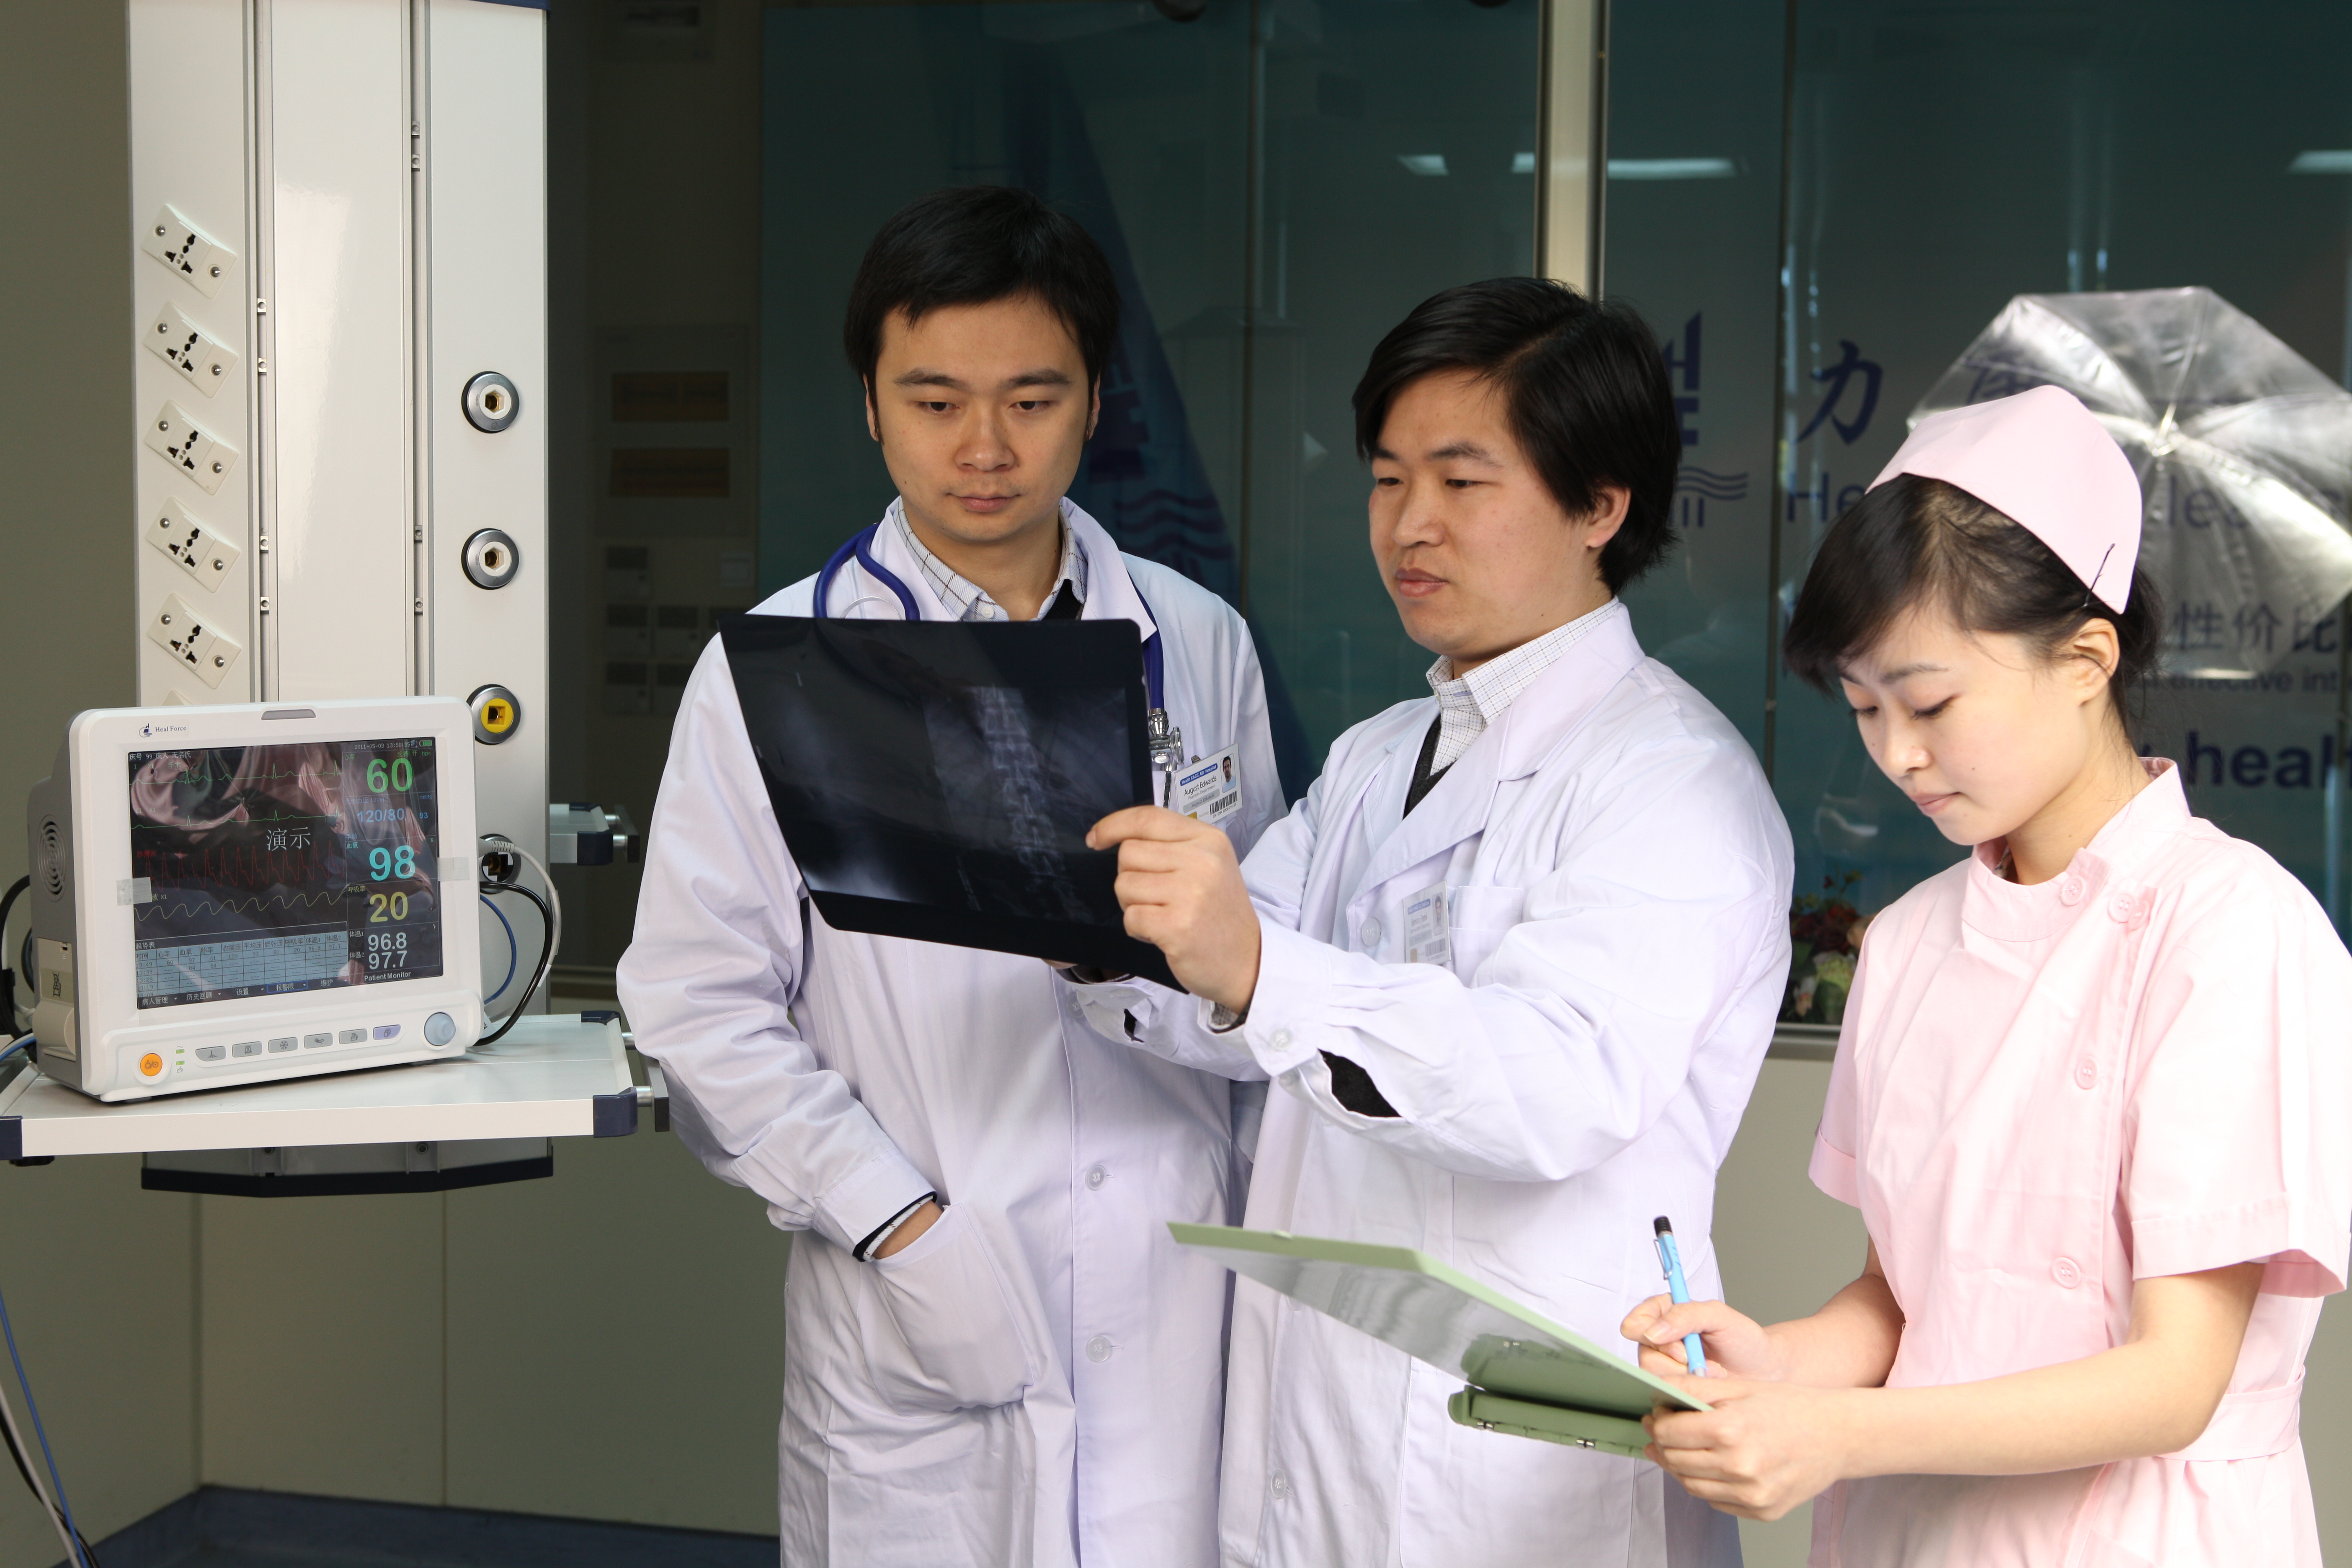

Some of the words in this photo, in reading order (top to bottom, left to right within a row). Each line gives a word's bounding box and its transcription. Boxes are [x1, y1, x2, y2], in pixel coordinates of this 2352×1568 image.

[2186, 730, 2352, 790] heal
[367, 758, 413, 793] 60
[1184, 785, 1199, 796] August
[1200, 775, 1217, 789] Edwards
[1200, 784, 1215, 795] Department
[357, 808, 405, 823] 120/80
[266, 827, 311, 851] 演示
[369, 845, 416, 881] 98
[369, 892, 408, 923] 20
[135, 941, 155, 950] 趋势表
[368, 932, 407, 952] 96.8
[369, 950, 407, 970] 97.7
[364, 972, 386, 982] Patient
[142, 996, 168, 1006] 病人管理
[186, 991, 212, 1001] 历史回顾
[236, 987, 249, 996] 设置
